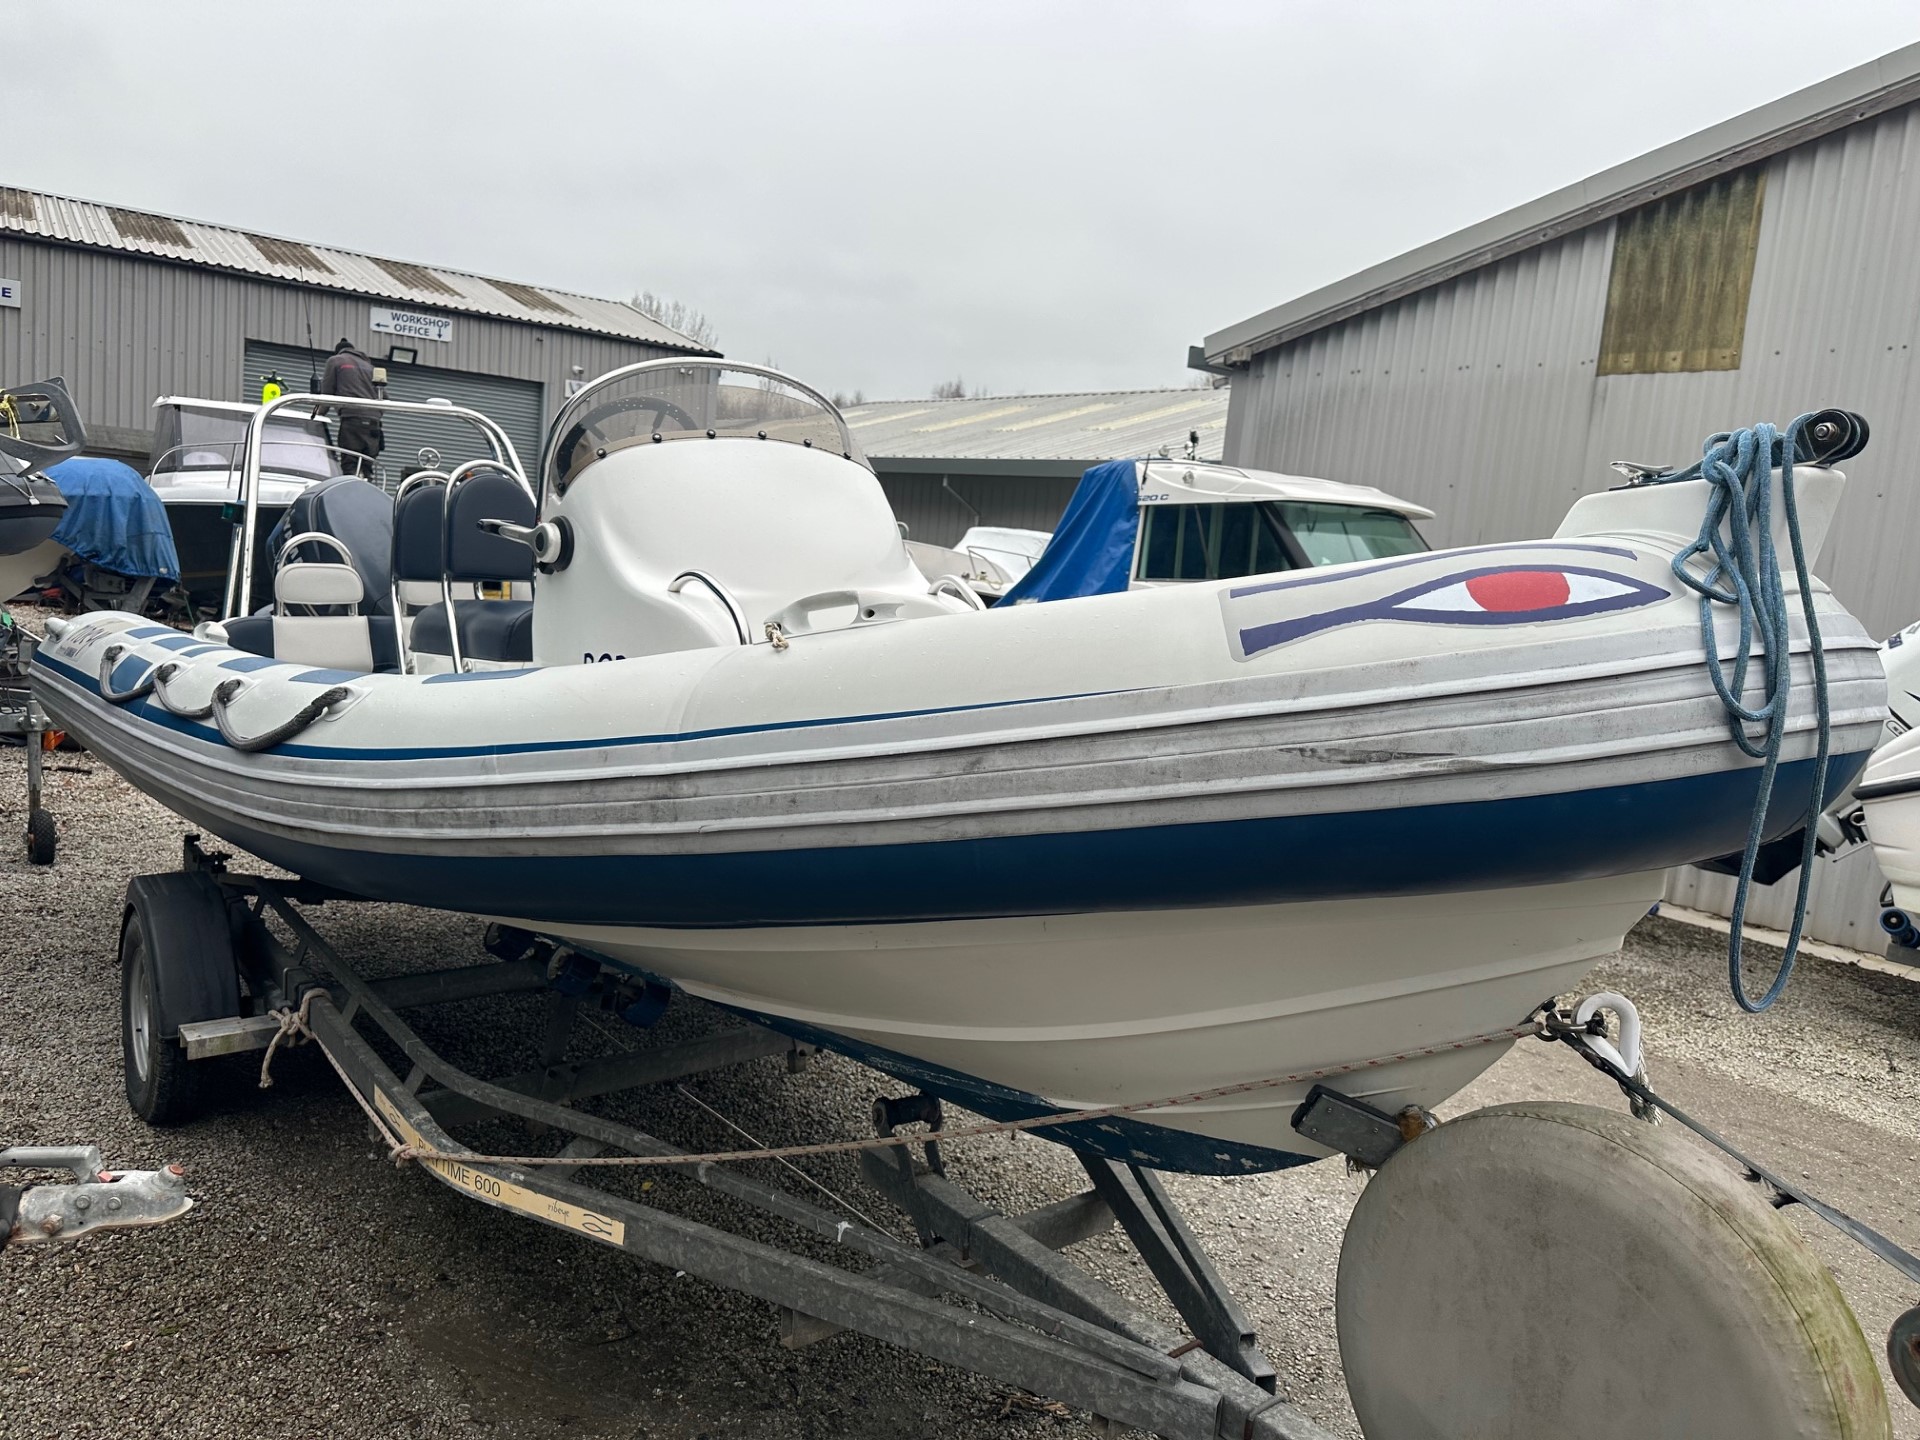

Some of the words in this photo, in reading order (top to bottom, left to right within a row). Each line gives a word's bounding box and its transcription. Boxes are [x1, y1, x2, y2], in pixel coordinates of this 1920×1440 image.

[391, 312, 450, 329] WORKSHOP
[394, 323, 430, 337] OFFICE
[474, 1174, 501, 1197] 600
